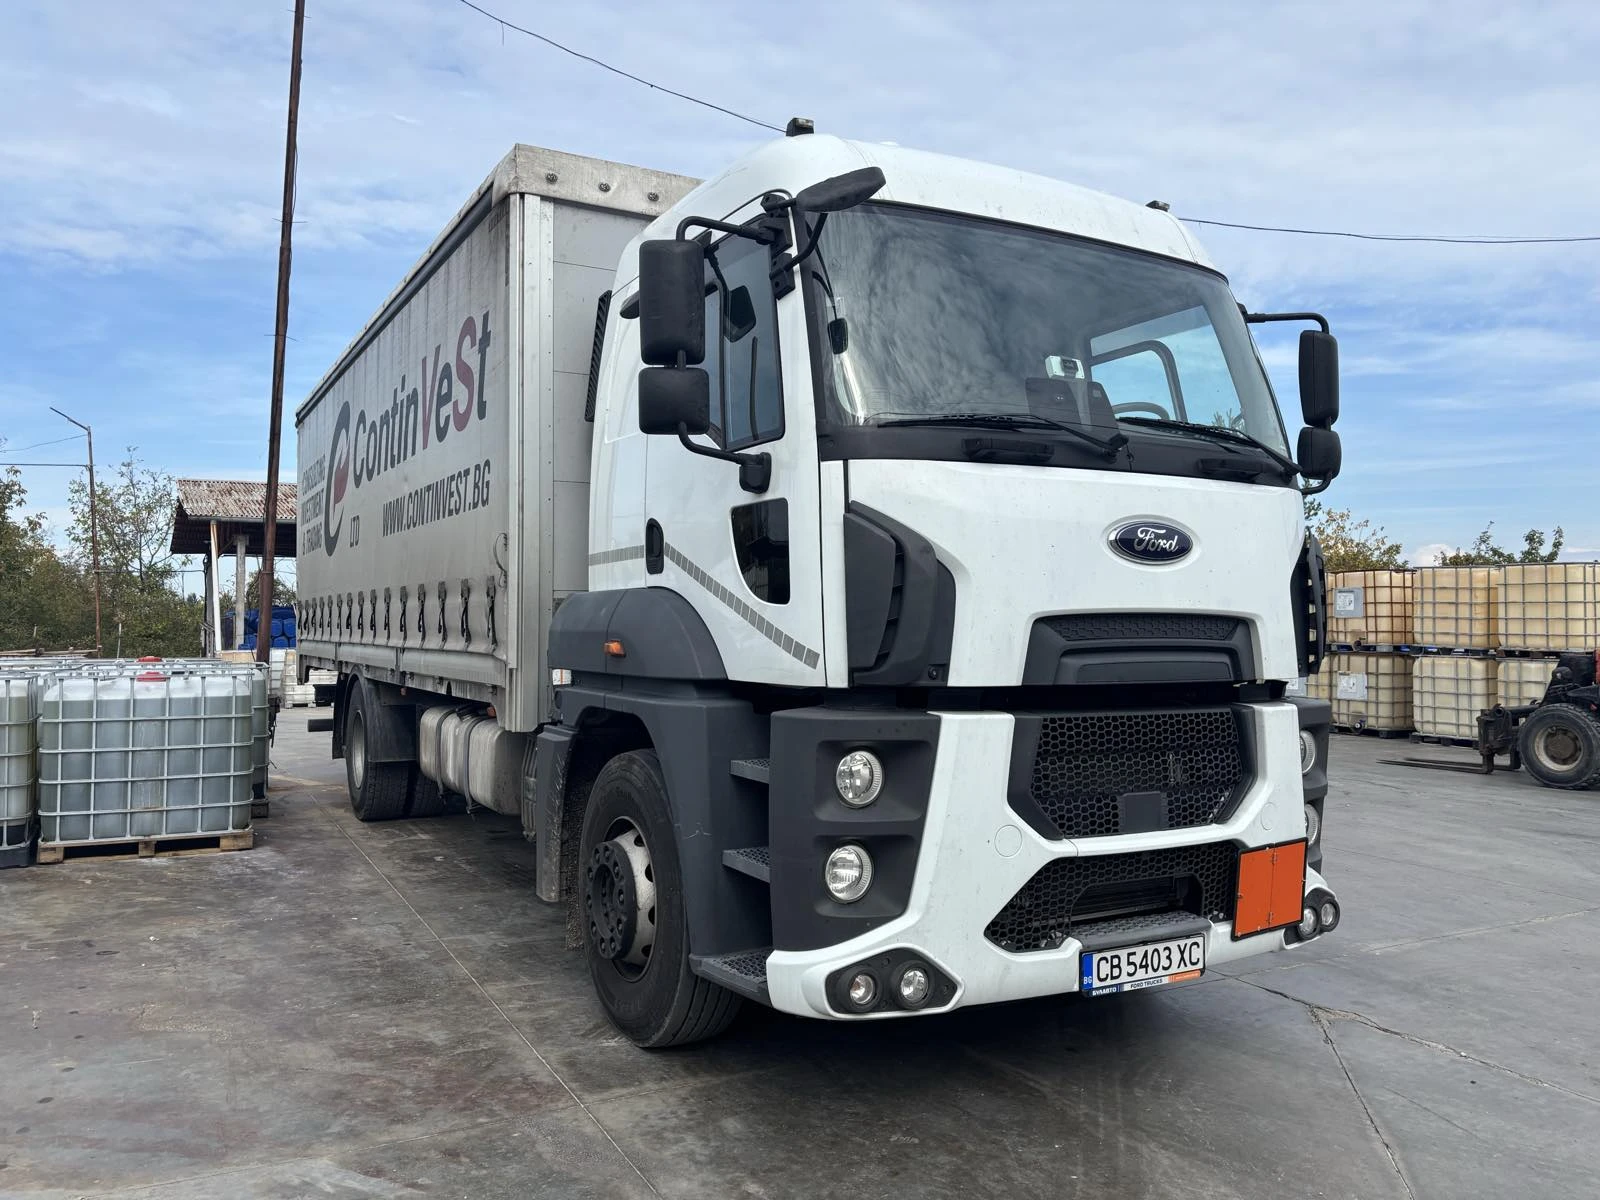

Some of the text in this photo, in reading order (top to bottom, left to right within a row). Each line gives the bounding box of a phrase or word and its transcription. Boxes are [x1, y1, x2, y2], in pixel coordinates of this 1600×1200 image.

[382, 458, 491, 537] WWW.CONTINVEST.BG
[350, 515, 360, 548] LTD
[1133, 527, 1178, 552] Ford
[1097, 941, 1200, 982] CB 5403 XC
[1083, 976, 1093, 985] BG
[1130, 978, 1163, 989] FORD TRUCKS
